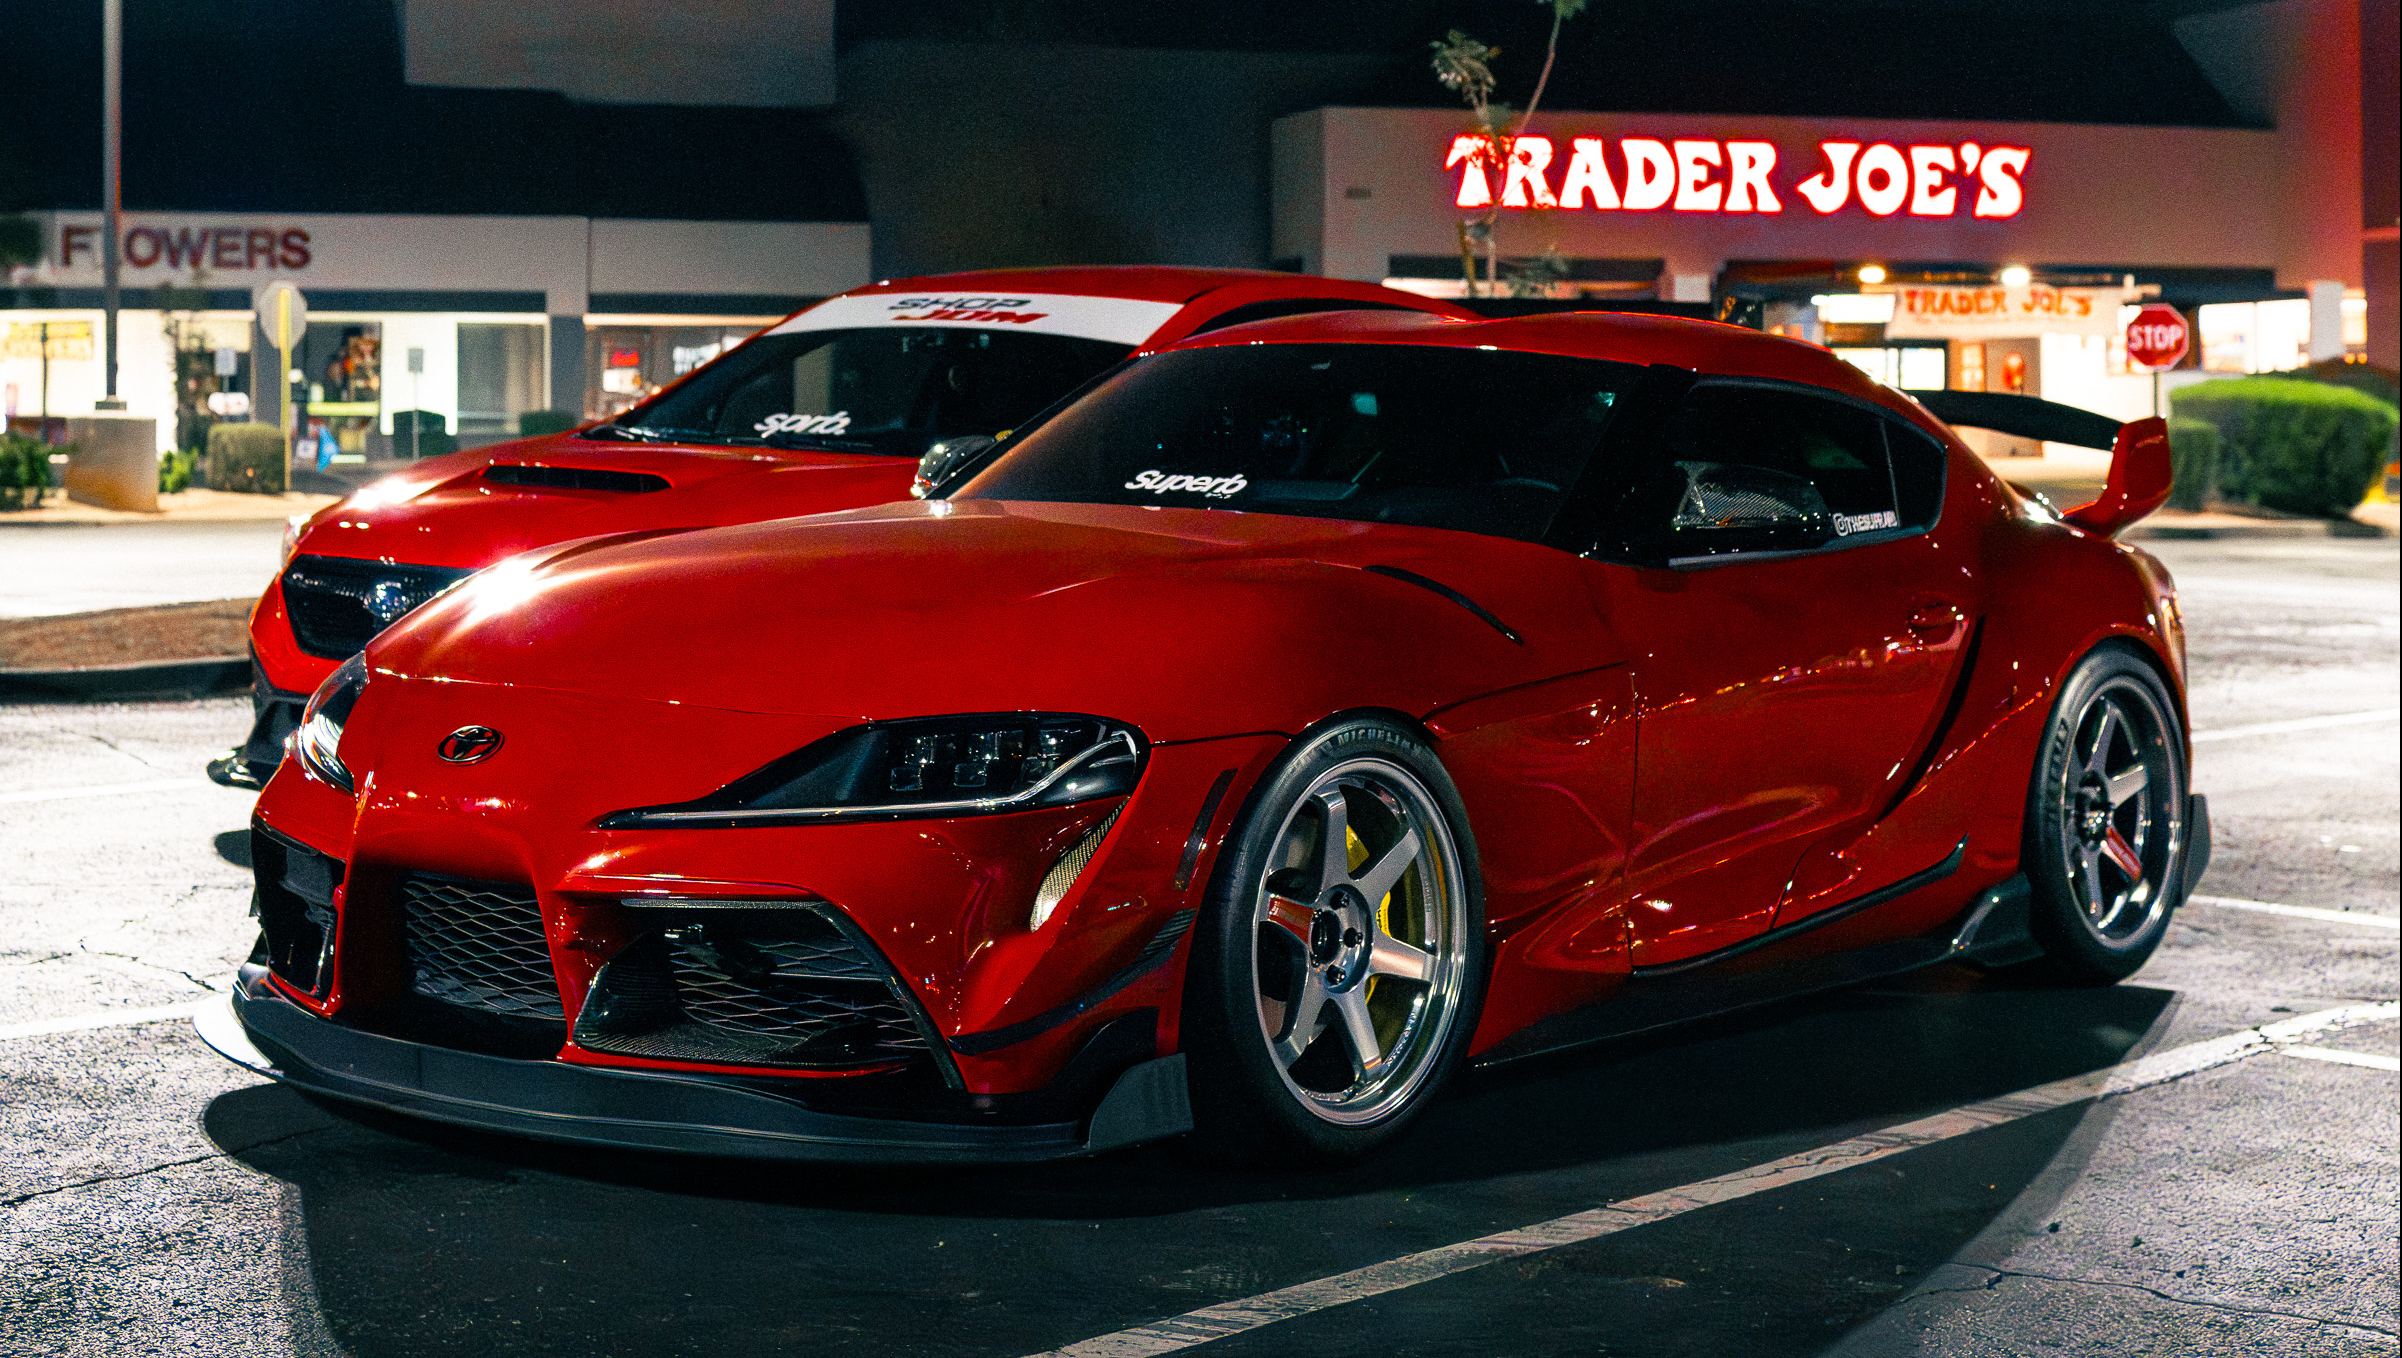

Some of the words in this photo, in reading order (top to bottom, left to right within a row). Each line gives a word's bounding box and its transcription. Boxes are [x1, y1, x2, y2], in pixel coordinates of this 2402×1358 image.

[1443, 134, 1783, 214] TRADER
[1796, 141, 2033, 218] JOE'S
[60, 224, 312, 270] FOWERS
[888, 297, 1032, 311] SHOP
[2128, 323, 2185, 352] STOP
[1124, 469, 1248, 494] Superb
